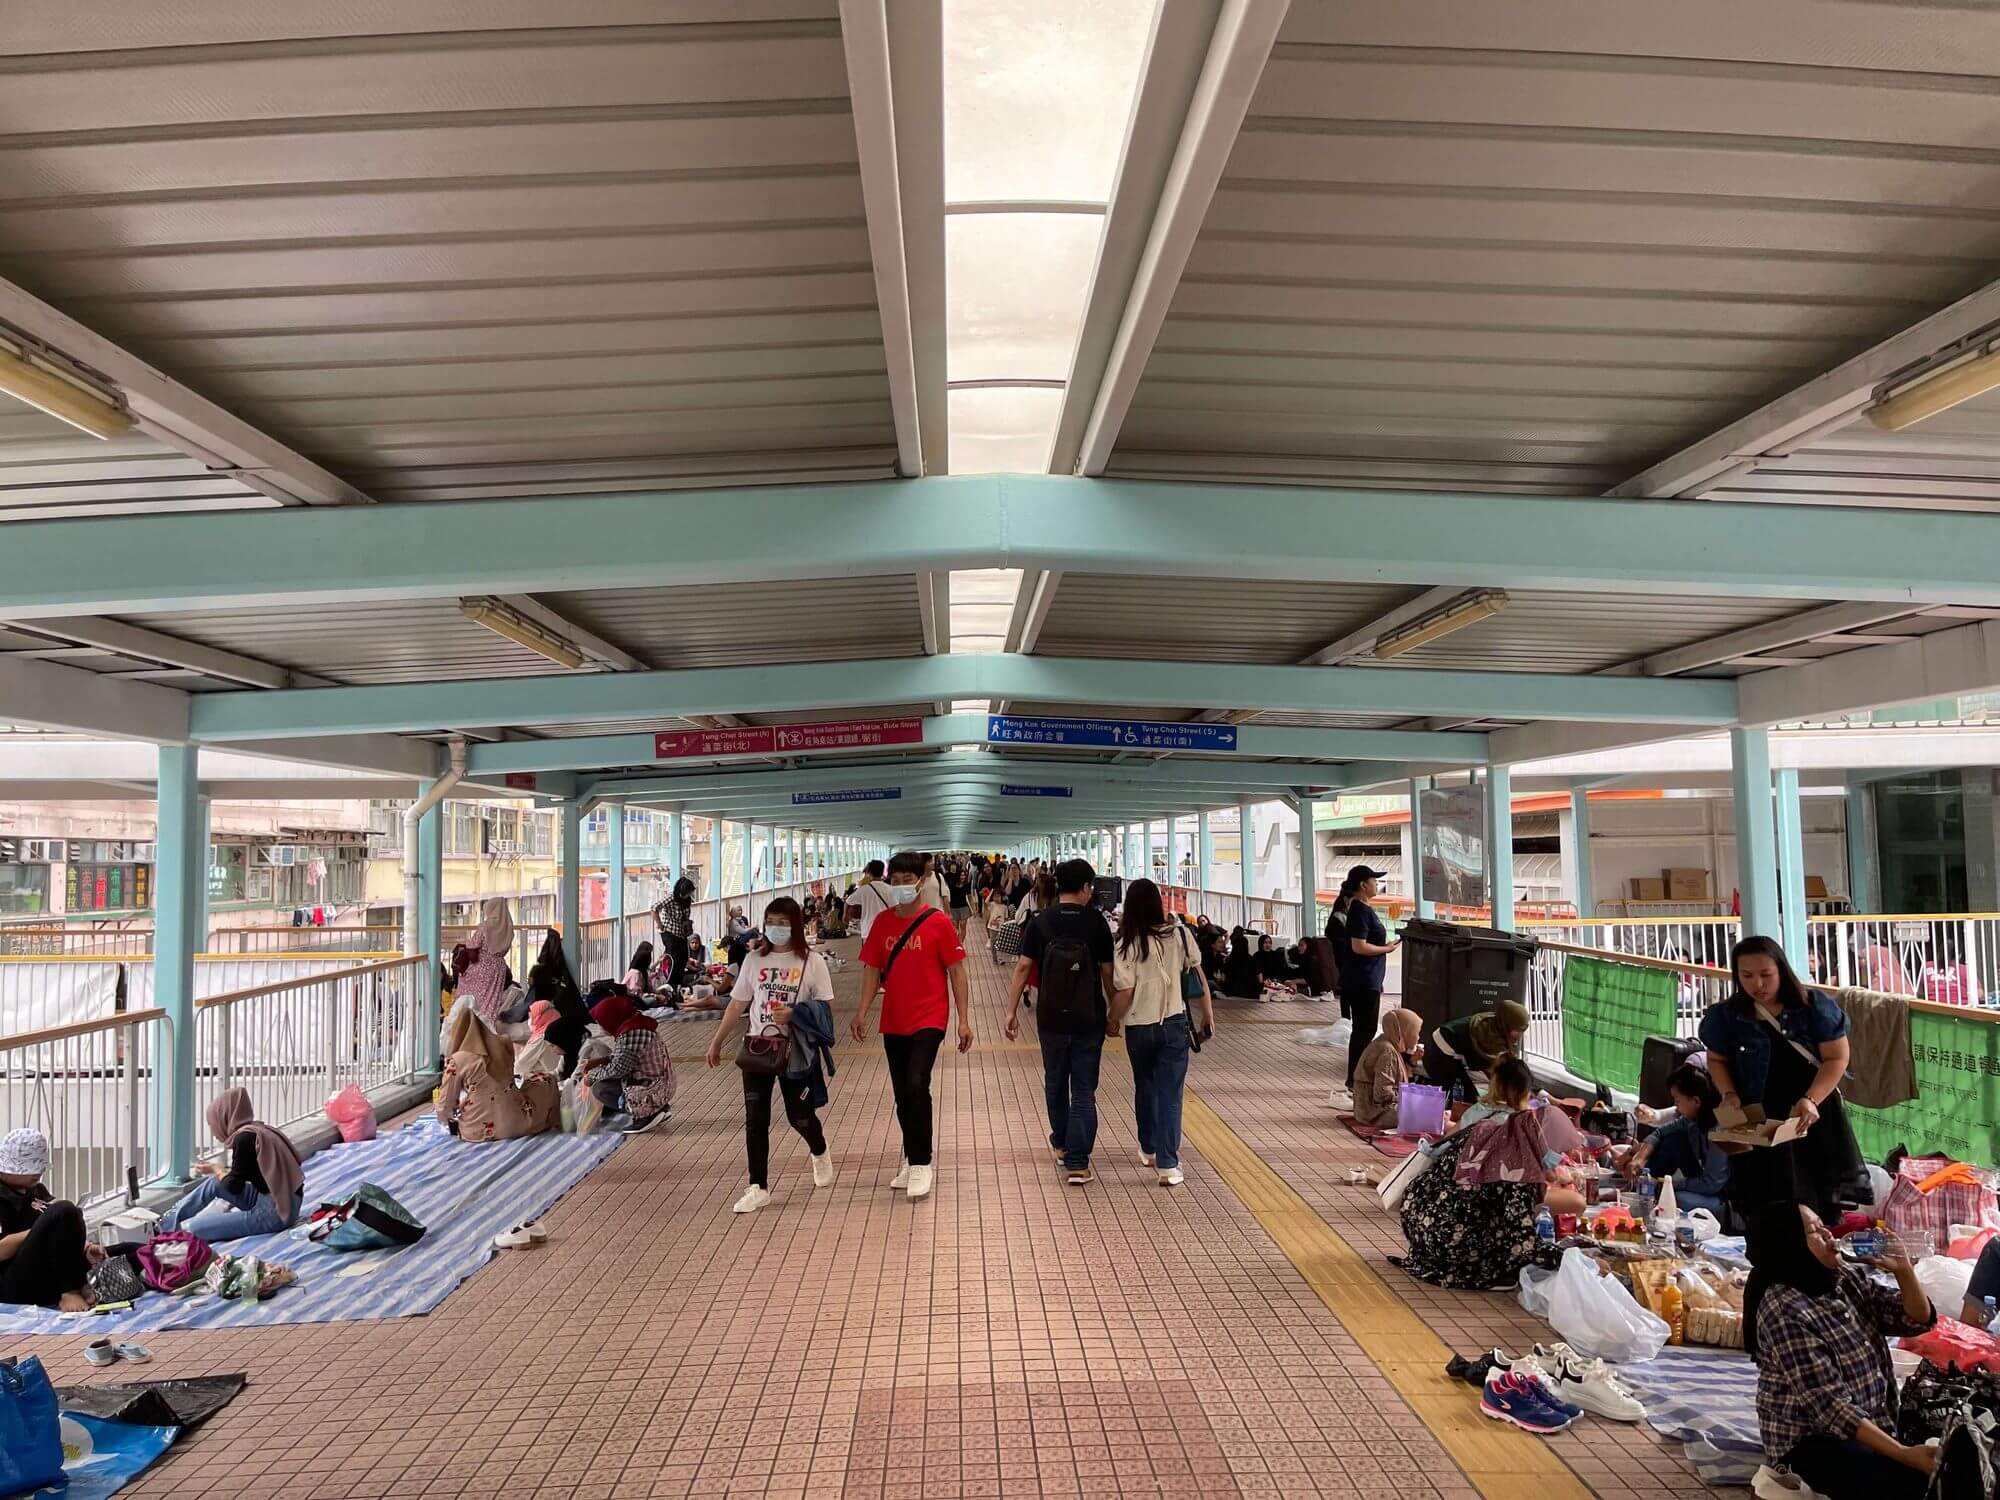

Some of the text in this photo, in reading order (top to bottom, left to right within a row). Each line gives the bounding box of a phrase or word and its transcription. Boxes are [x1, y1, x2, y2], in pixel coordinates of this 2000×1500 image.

[900, 721, 920, 729] Street
[1002, 720, 1023, 728] Mong
[1041, 721, 1085, 730] Government
[1086, 723, 1113, 731] Offices
[1142, 725, 1217, 736] Tung Choi Street (S)
[1002, 729, 1064, 741] 旺角政府合署
[758, 967, 800, 983] STOP
